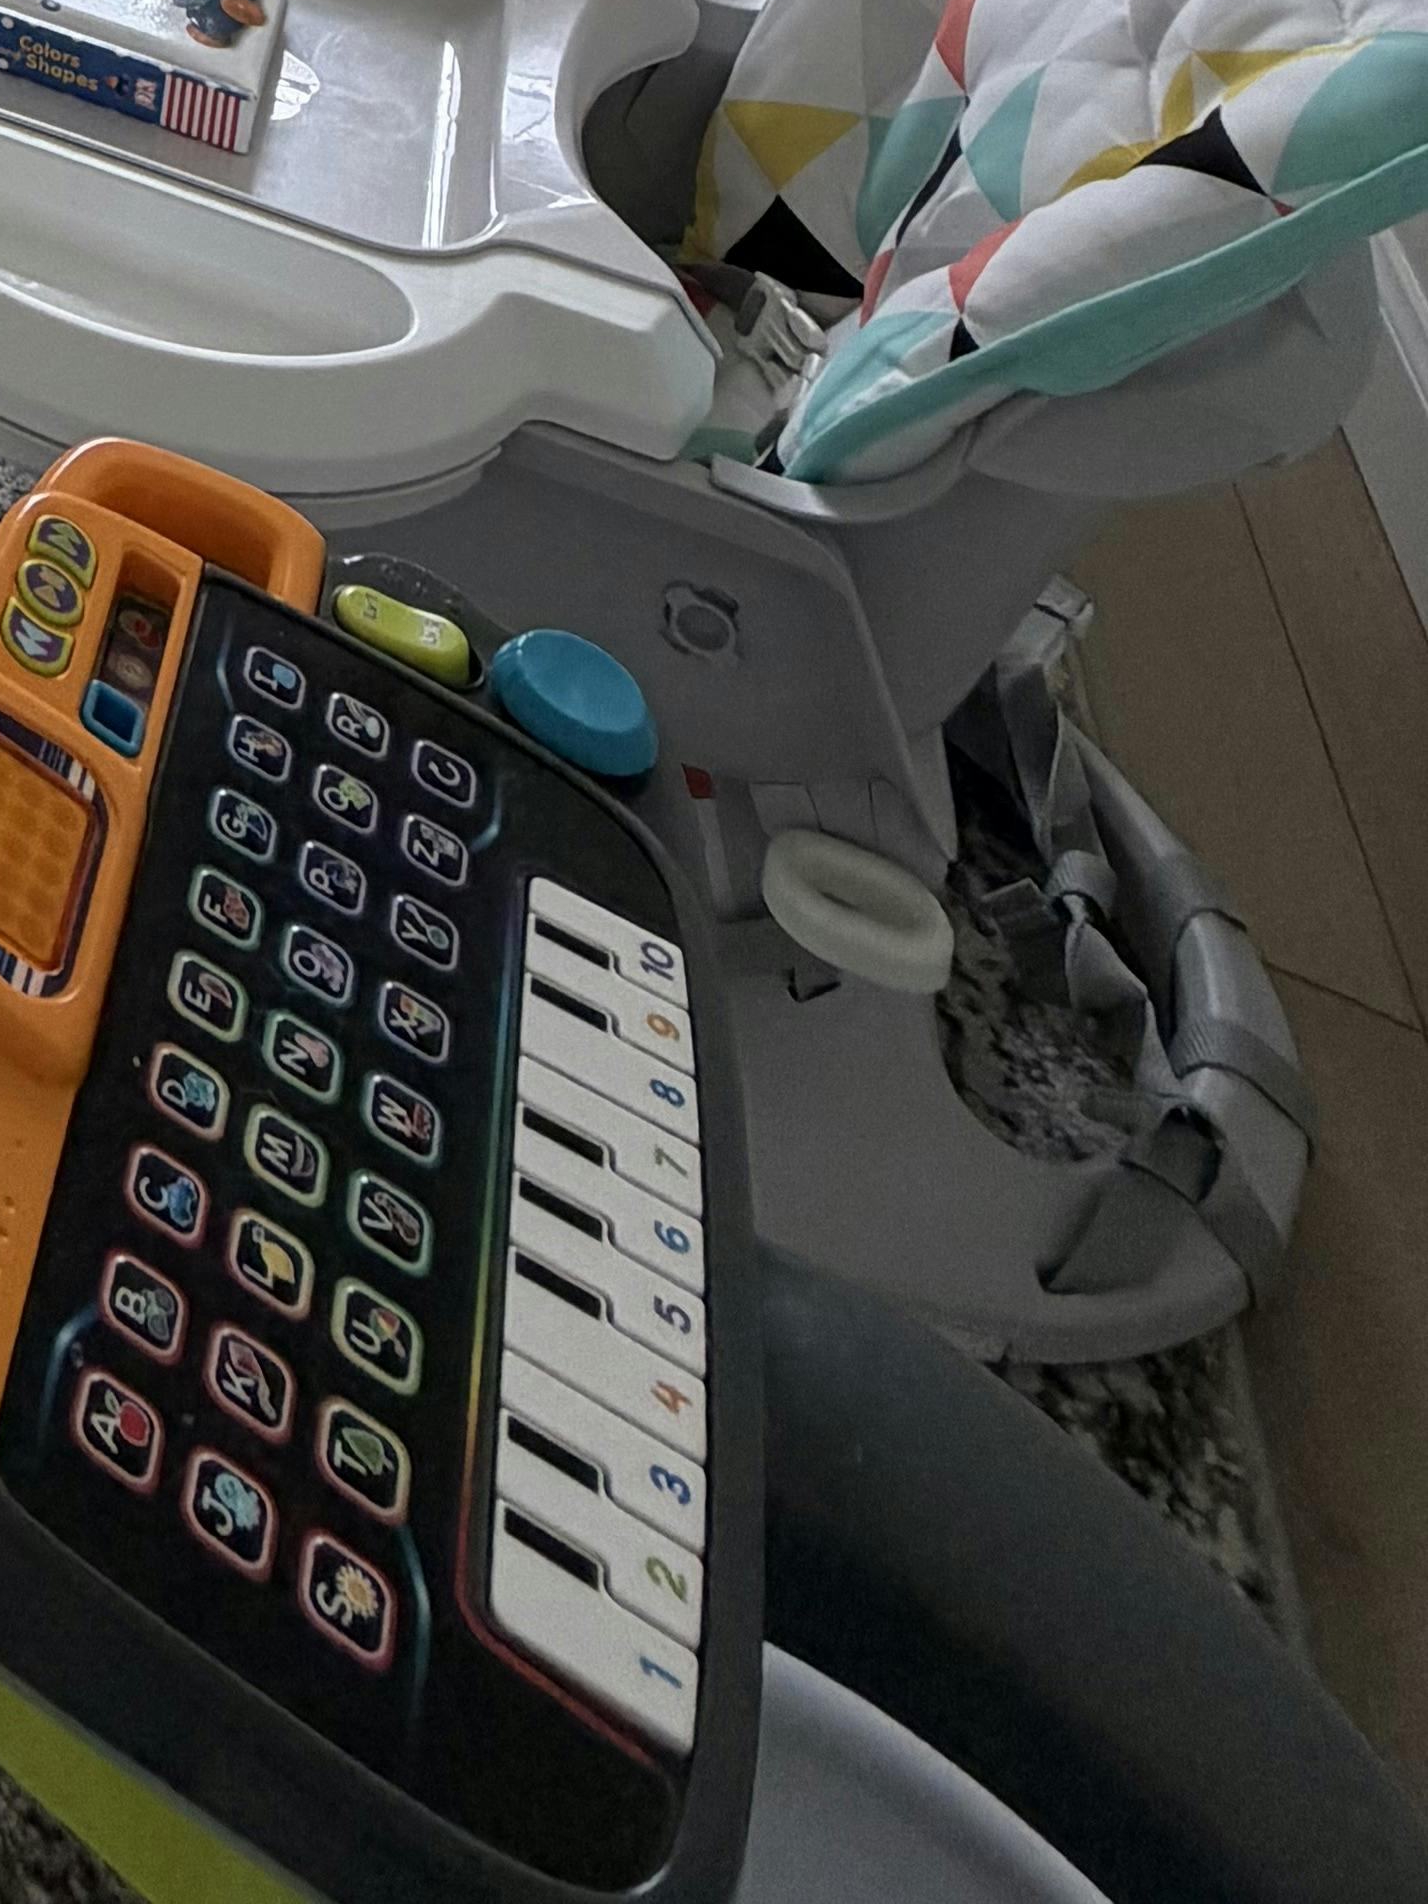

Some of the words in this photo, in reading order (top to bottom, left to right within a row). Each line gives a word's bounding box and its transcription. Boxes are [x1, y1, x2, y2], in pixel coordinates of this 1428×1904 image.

[18, 34, 81, 69] Colors
[25, 54, 99, 92] Shapes
[336, 714, 363, 740] R
[413, 839, 440, 867] Z
[309, 867, 335, 896] P
[400, 918, 427, 943] Y
[293, 949, 321, 978] O
[639, 940, 675, 982] 10
[390, 1008, 417, 1041] X
[646, 1012, 680, 1042] 9
[90, 1411, 121, 1455] A
[114, 1286, 147, 1325] B
[139, 1176, 170, 1211] C
[161, 1078, 189, 1110] D
[185, 980, 211, 1013] E
[203, 893, 229, 924] F
[220, 812, 247, 840] G
[238, 733, 261, 764] H
[254, 670, 278, 691] I
[279, 1042, 308, 1076] N
[649, 1077, 686, 1109] 8
[378, 1093, 414, 1138] W
[260, 1133, 293, 1175] M
[654, 1143, 689, 1179] 7
[362, 1196, 393, 1232] V
[654, 1220, 691, 1255] 6
[244, 1262, 274, 1289] L
[652, 1295, 692, 1335] 5
[349, 1318, 382, 1356] U
[223, 1361, 257, 1404] K
[651, 1379, 694, 1417] 4
[334, 1438, 368, 1477] T
[649, 1464, 692, 1507] 3
[201, 1485, 234, 1537] J
[645, 1555, 688, 1604] 2
[315, 1581, 353, 1627] S
[638, 1655, 683, 1691] 1
